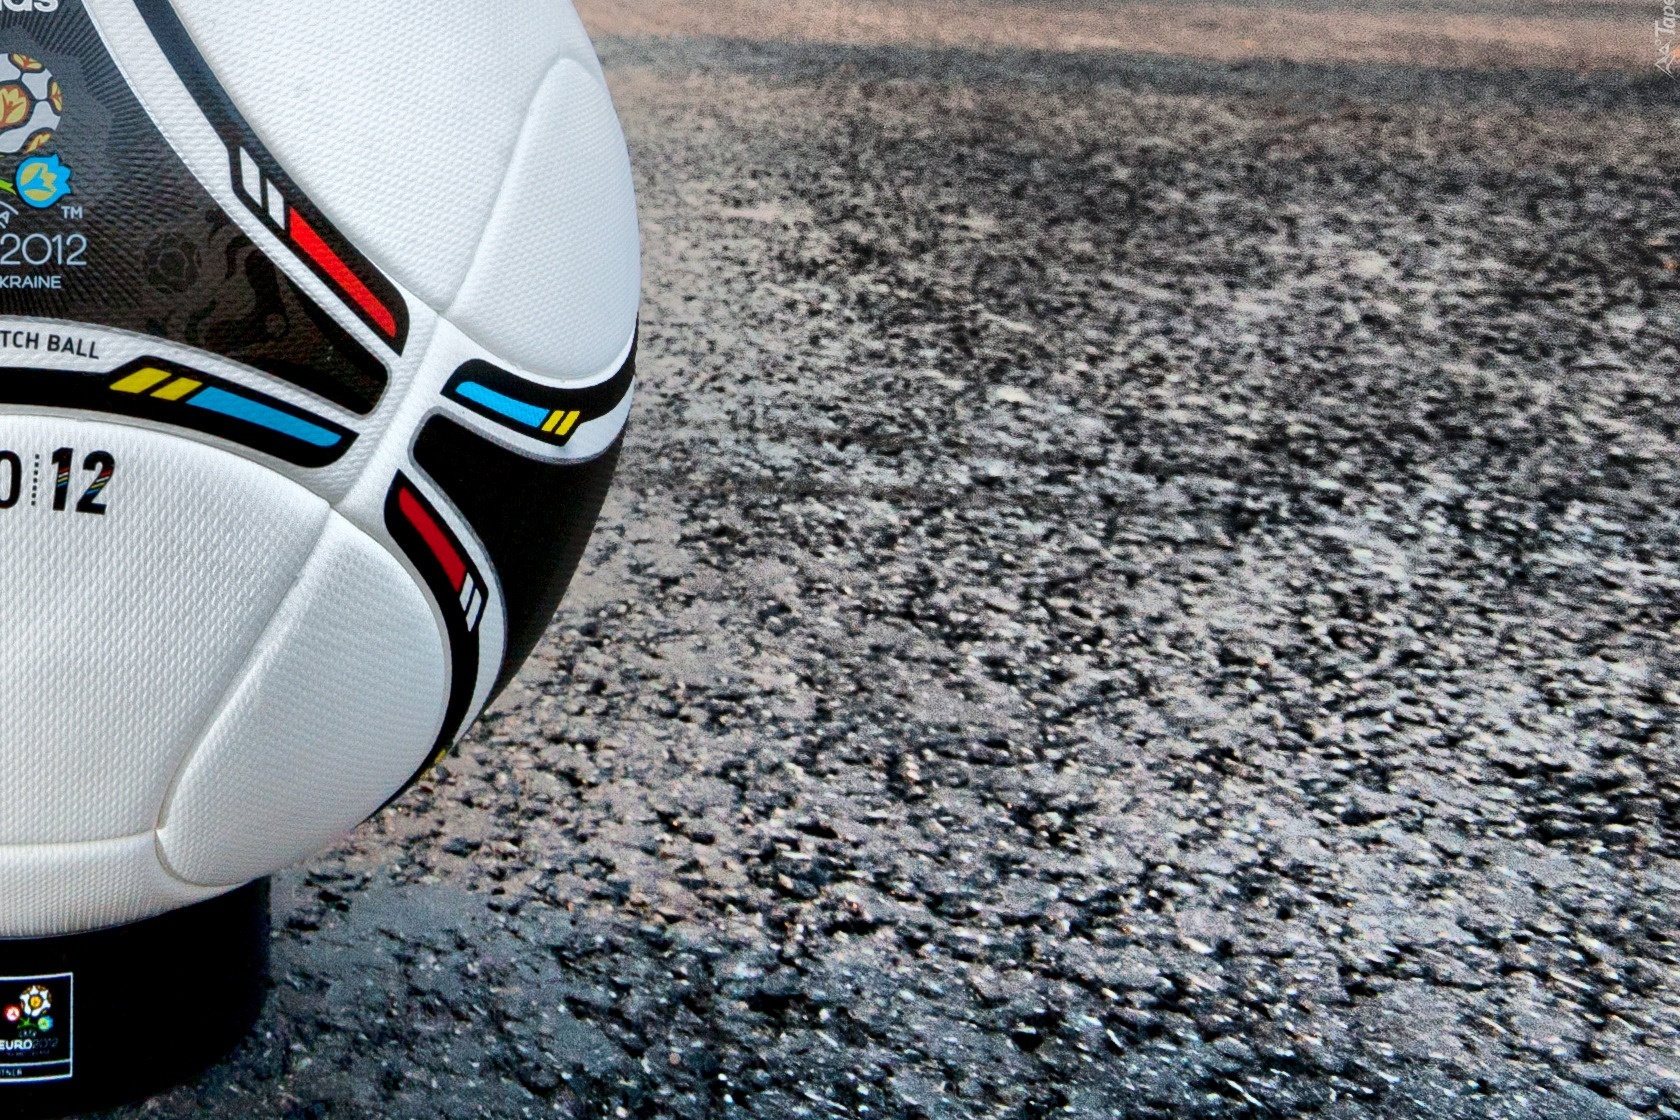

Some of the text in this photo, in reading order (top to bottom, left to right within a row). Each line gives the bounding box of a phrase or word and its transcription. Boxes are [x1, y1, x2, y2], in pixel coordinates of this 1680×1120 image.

[61, 206, 83, 220] TM
[47, 334, 100, 360] BALL
[51, 446, 116, 516] 12
